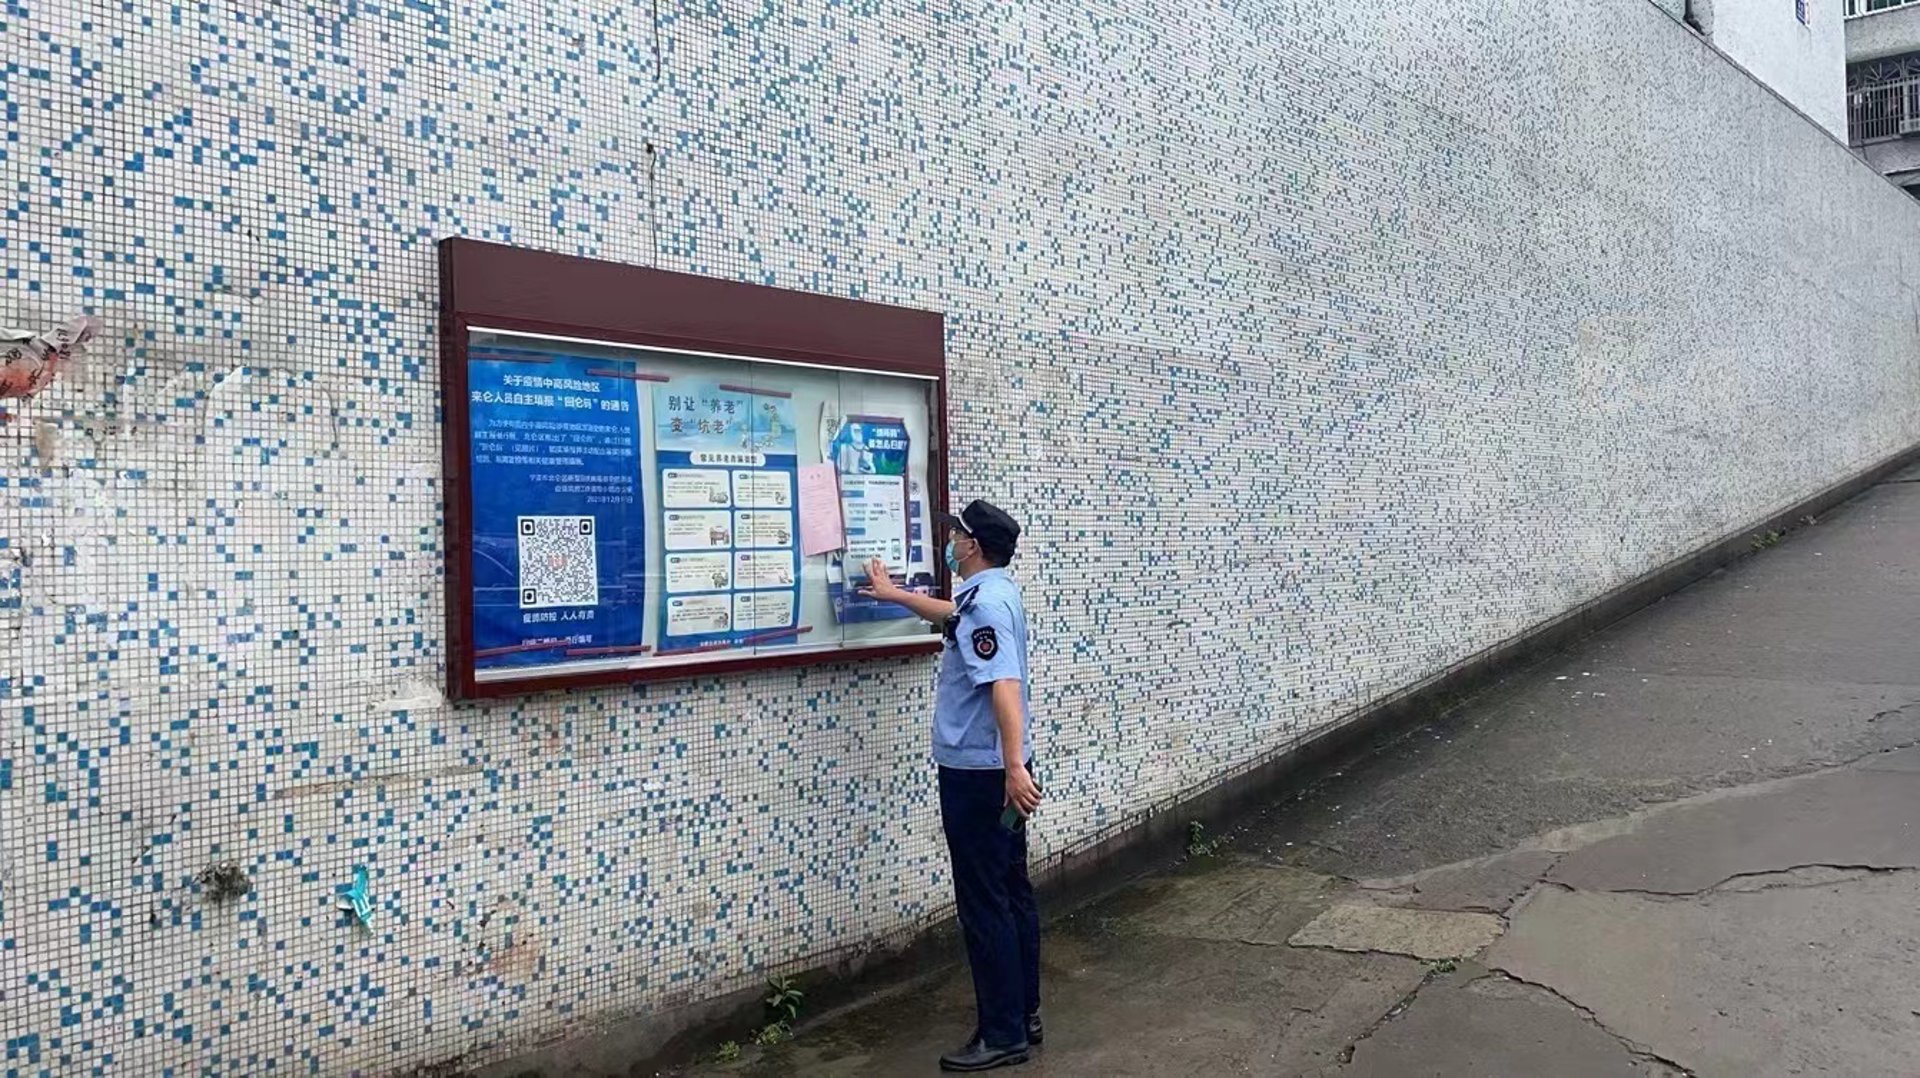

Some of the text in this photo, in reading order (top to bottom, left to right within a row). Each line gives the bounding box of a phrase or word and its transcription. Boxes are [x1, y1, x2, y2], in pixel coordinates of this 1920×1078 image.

[503, 374, 601, 393] 关于疫情中高风险地区
